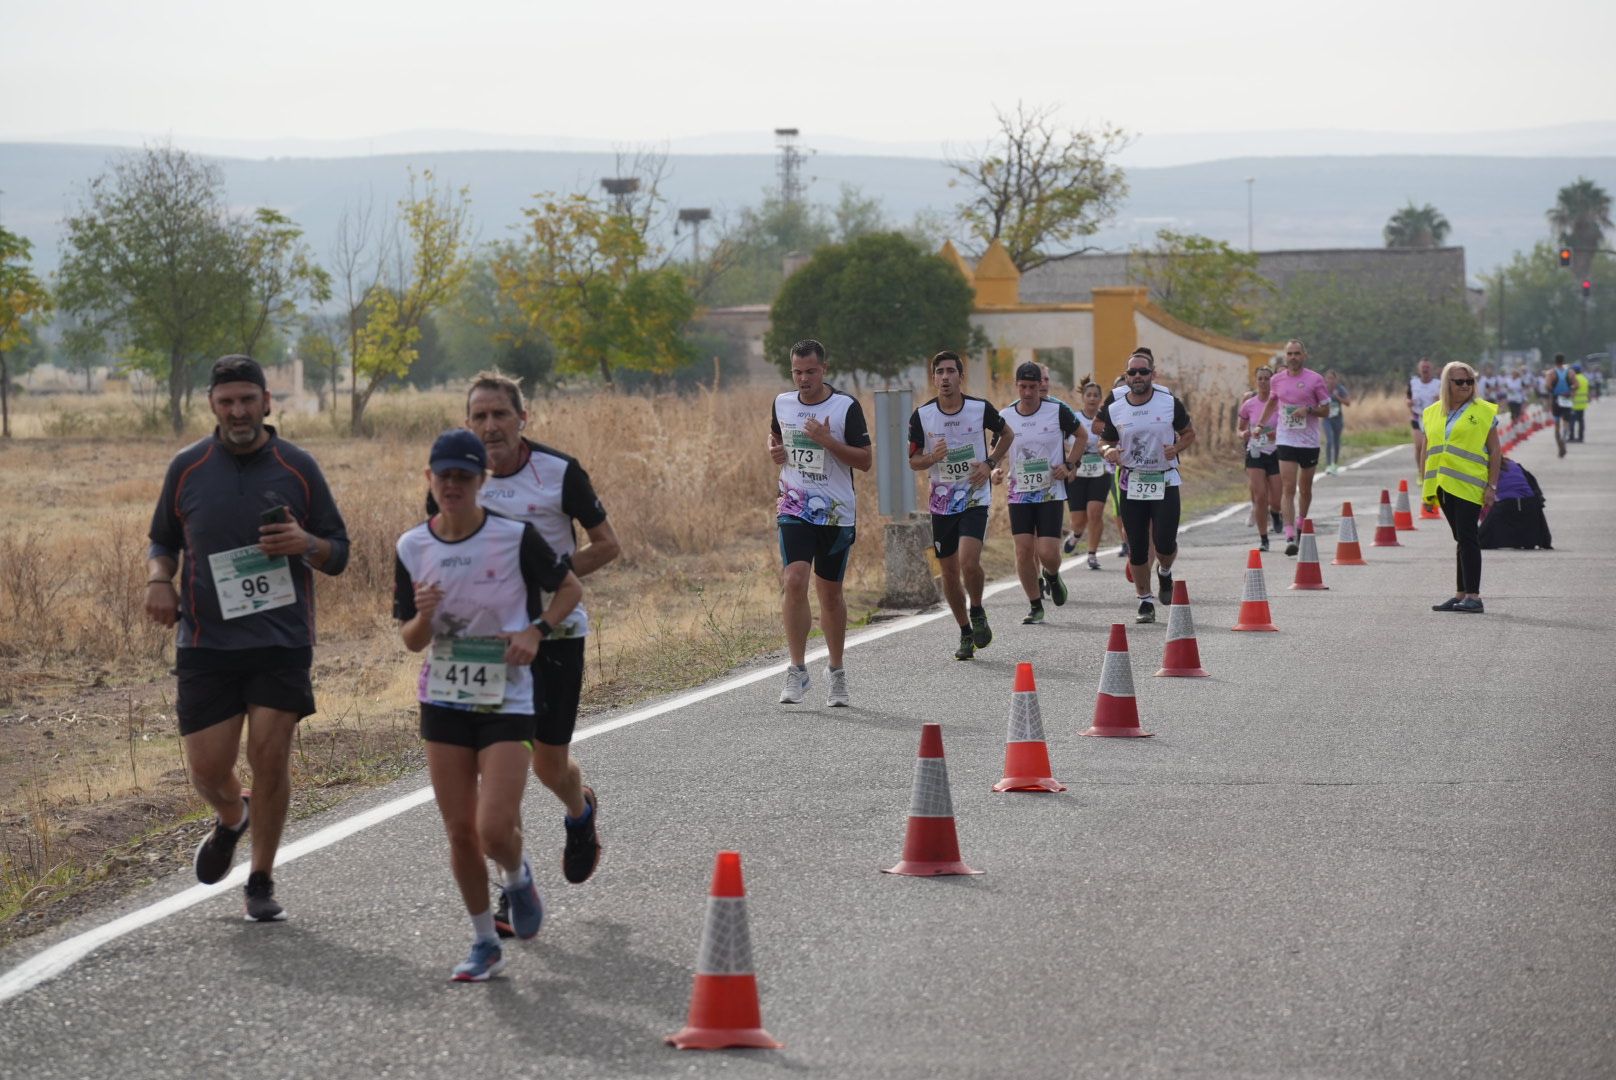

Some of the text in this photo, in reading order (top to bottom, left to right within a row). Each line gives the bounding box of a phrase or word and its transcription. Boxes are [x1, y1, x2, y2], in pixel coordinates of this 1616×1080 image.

[791, 449, 813, 464] 173
[946, 462, 970, 475] 308
[1023, 473, 1043, 485] 378
[1136, 483, 1157, 494] 379
[242, 575, 270, 598] 96
[445, 663, 488, 687] 414
